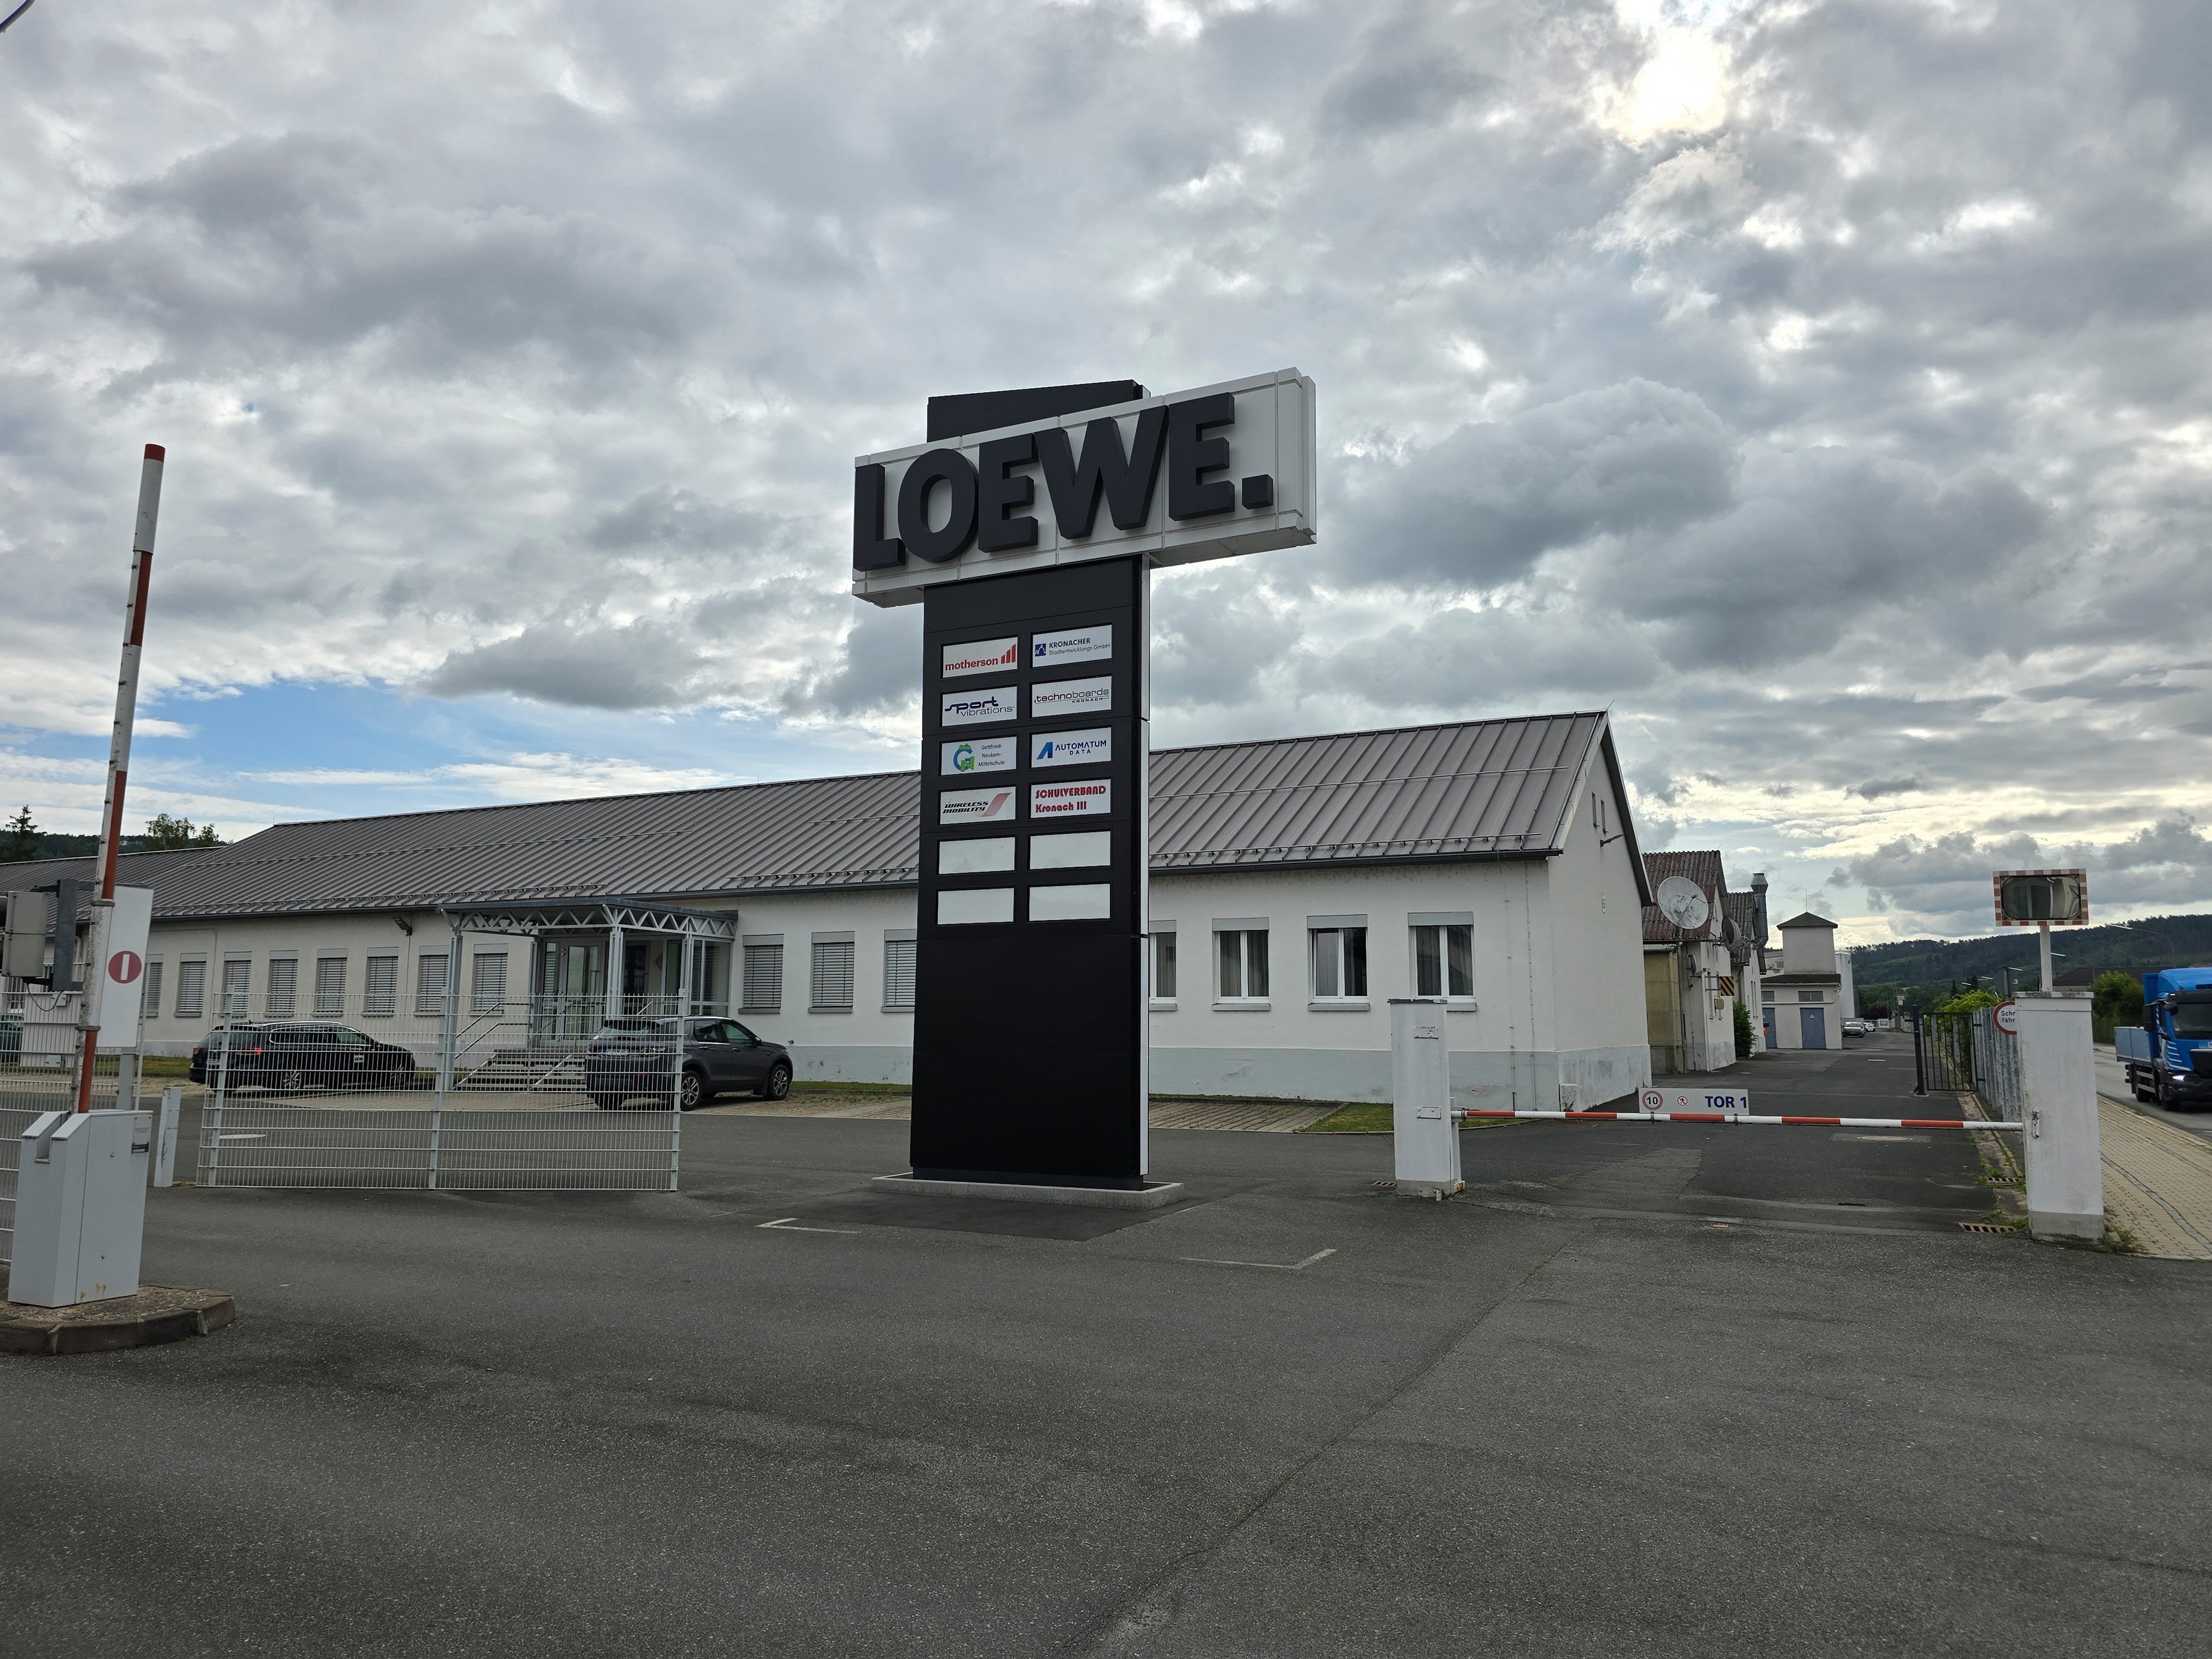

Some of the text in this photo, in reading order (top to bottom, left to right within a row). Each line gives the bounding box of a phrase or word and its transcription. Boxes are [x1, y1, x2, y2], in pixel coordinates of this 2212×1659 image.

[853, 392, 1274, 572] LOEWE.
[1049, 638, 1091, 649] KRONACHER
[1049, 645, 1093, 656] Stadtentwicklungs
[945, 658, 998, 671] motherson
[945, 696, 999, 714] sport
[1055, 740, 1107, 751] AUTOMATUM
[1035, 785, 1107, 799] SCHULVERBAND
[1036, 801, 1087, 813] Kronach III
[1646, 1096, 1658, 1105] 10
[1704, 1095, 1747, 1108] TOR 1
